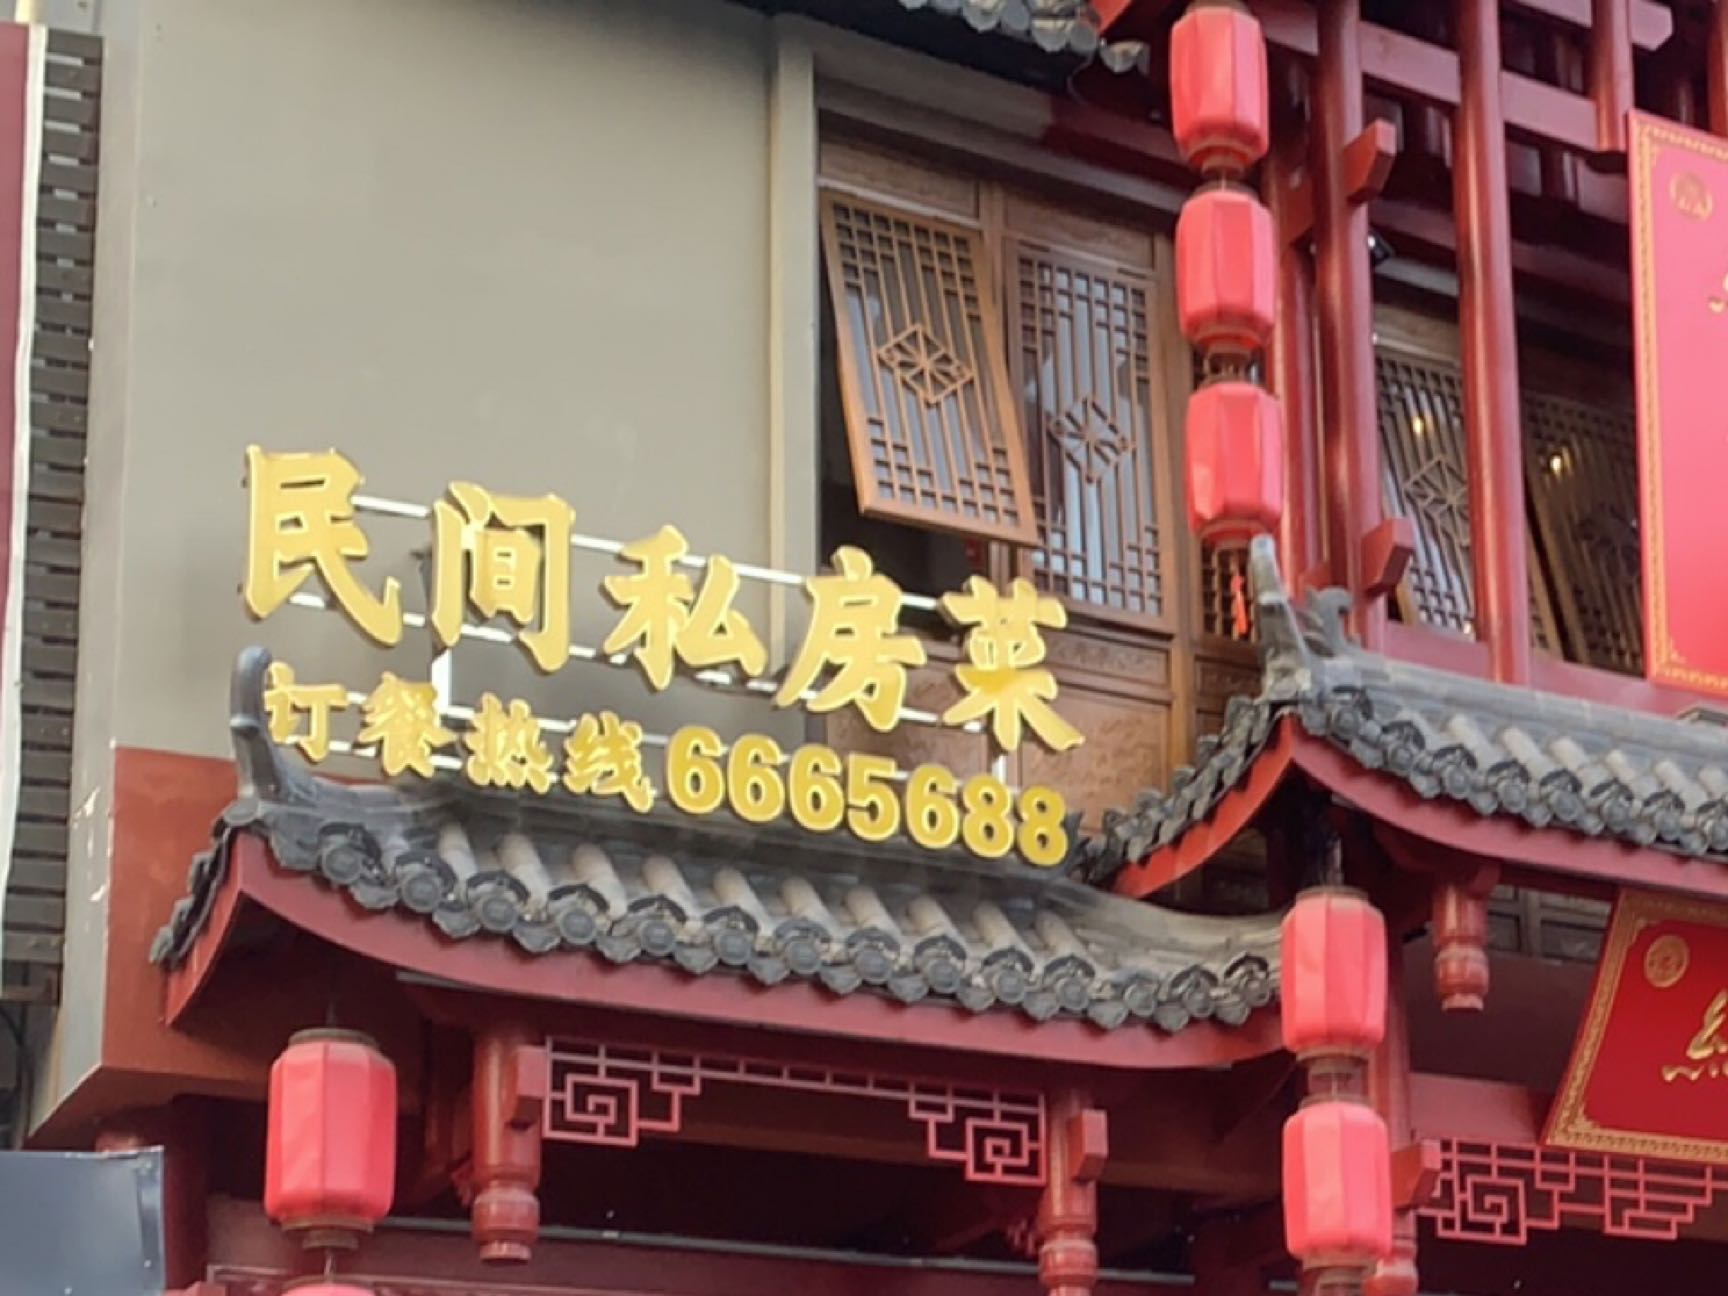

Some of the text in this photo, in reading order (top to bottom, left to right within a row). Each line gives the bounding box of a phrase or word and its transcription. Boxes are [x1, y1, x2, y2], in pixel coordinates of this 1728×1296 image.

[244, 444, 1084, 752] 民间私房菜
